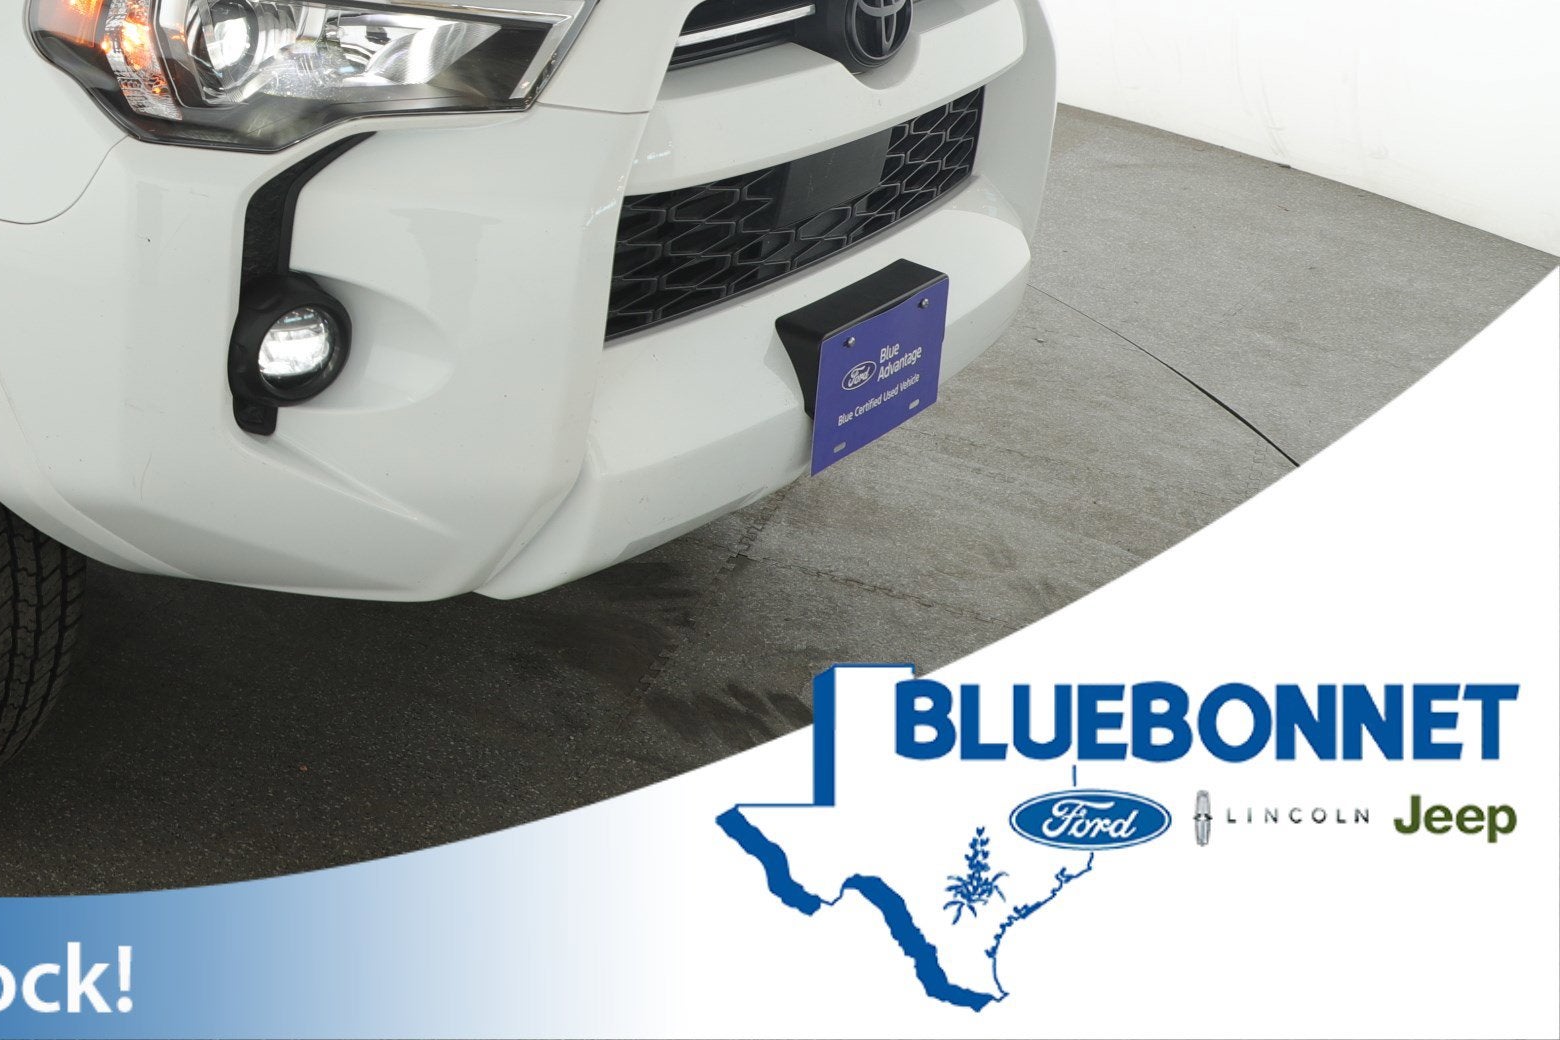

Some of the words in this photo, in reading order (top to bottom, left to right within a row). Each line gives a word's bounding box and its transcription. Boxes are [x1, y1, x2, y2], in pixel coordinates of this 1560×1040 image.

[877, 346, 923, 382] Advantage
[879, 343, 900, 364] Blue
[846, 364, 873, 388] Ford
[837, 411, 854, 427] Blue
[854, 393, 883, 417] Certified
[883, 384, 900, 402] Used
[899, 373, 921, 393] Vehicle
